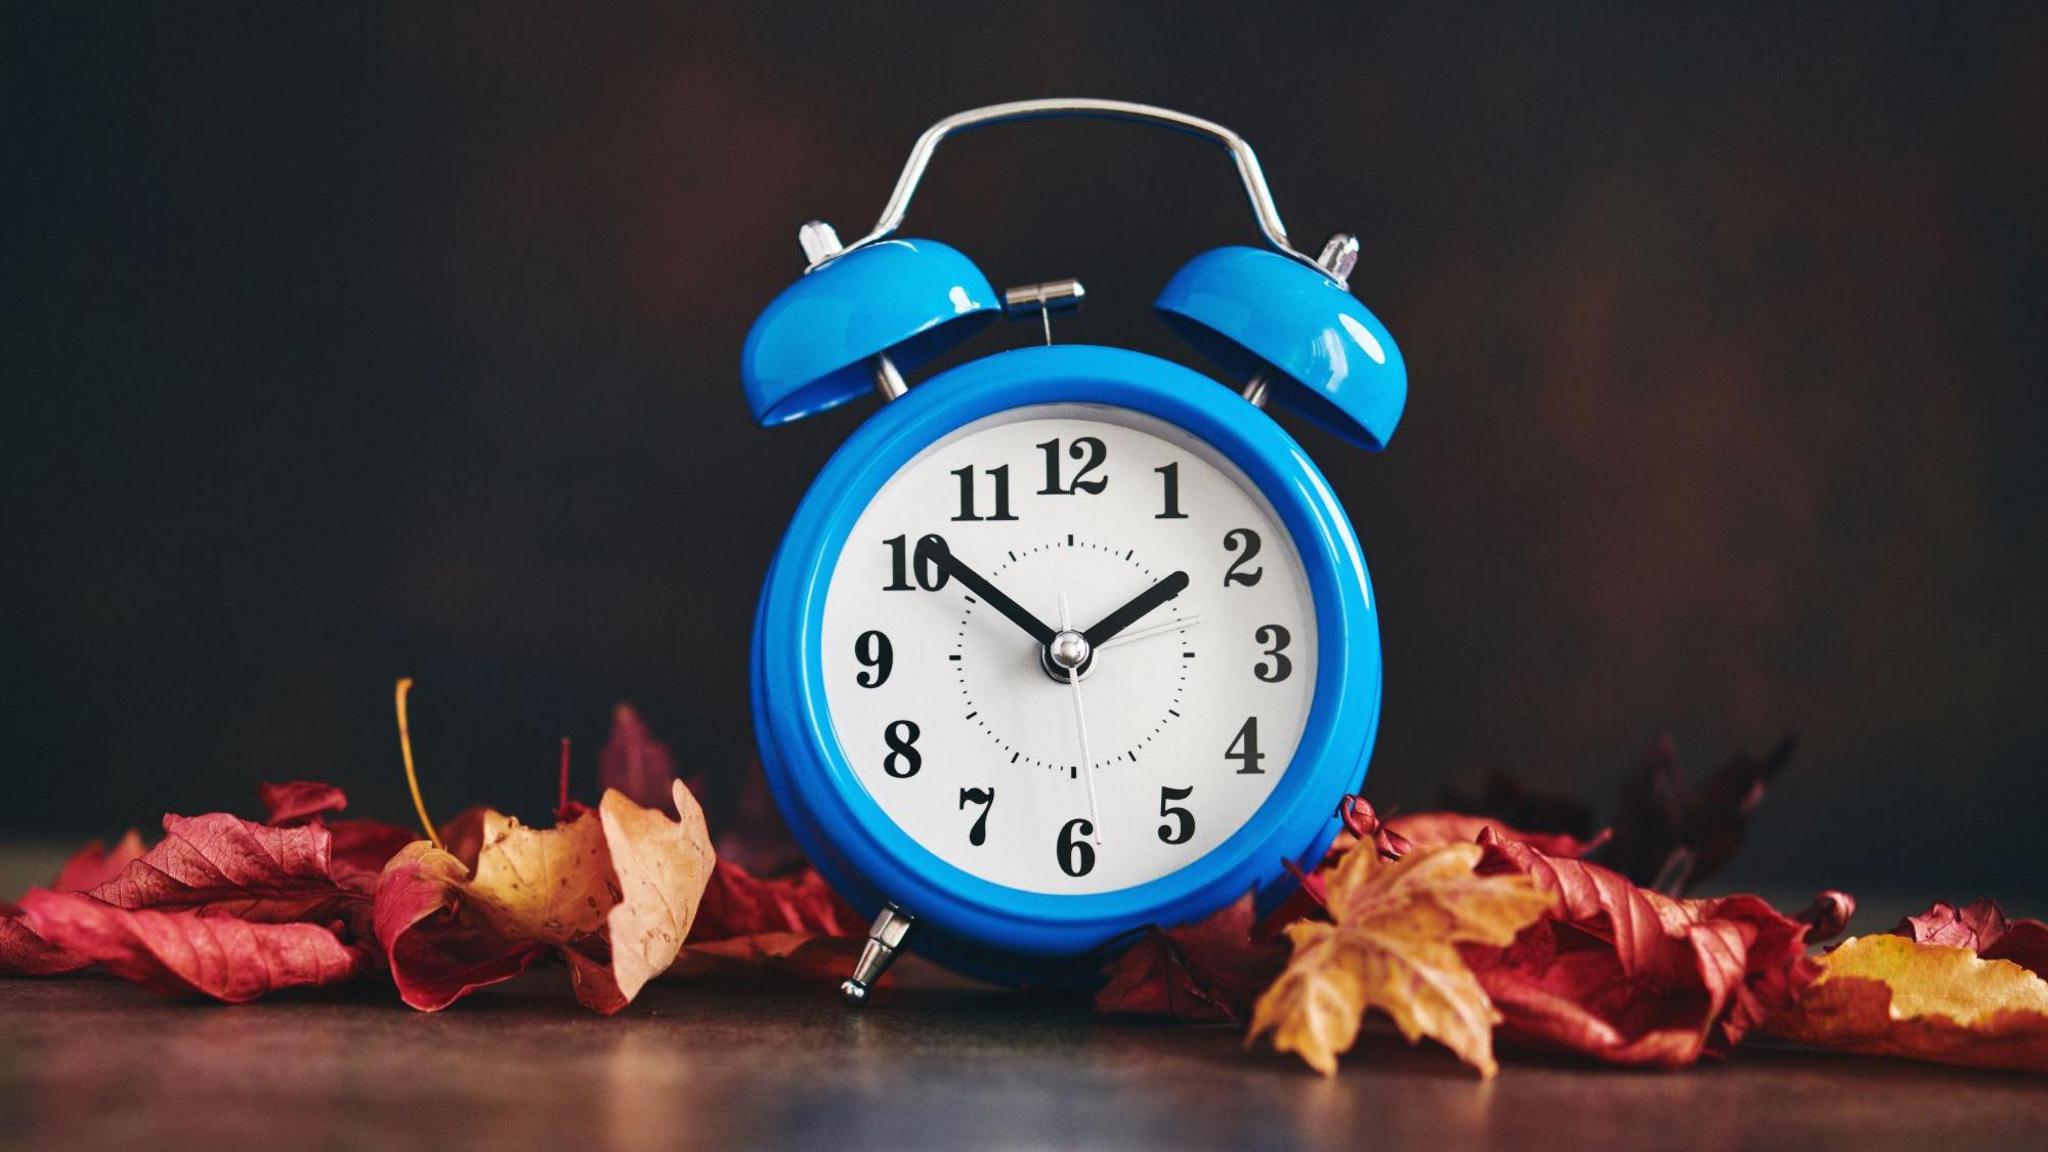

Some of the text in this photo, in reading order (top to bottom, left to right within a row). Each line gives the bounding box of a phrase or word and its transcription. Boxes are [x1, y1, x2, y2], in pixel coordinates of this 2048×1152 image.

[950, 464, 1019, 522] 11
[1036, 437, 1108, 496] 12
[1154, 462, 1189, 519] 1
[882, 533, 951, 592] 10
[1223, 528, 1263, 588] 2
[854, 630, 894, 689] 9
[1253, 624, 1293, 683] 3
[883, 719, 922, 779] 8
[1224, 716, 1265, 775] 4
[959, 787, 995, 847] 7
[1157, 785, 1196, 845] 5
[1056, 818, 1096, 877] 6
